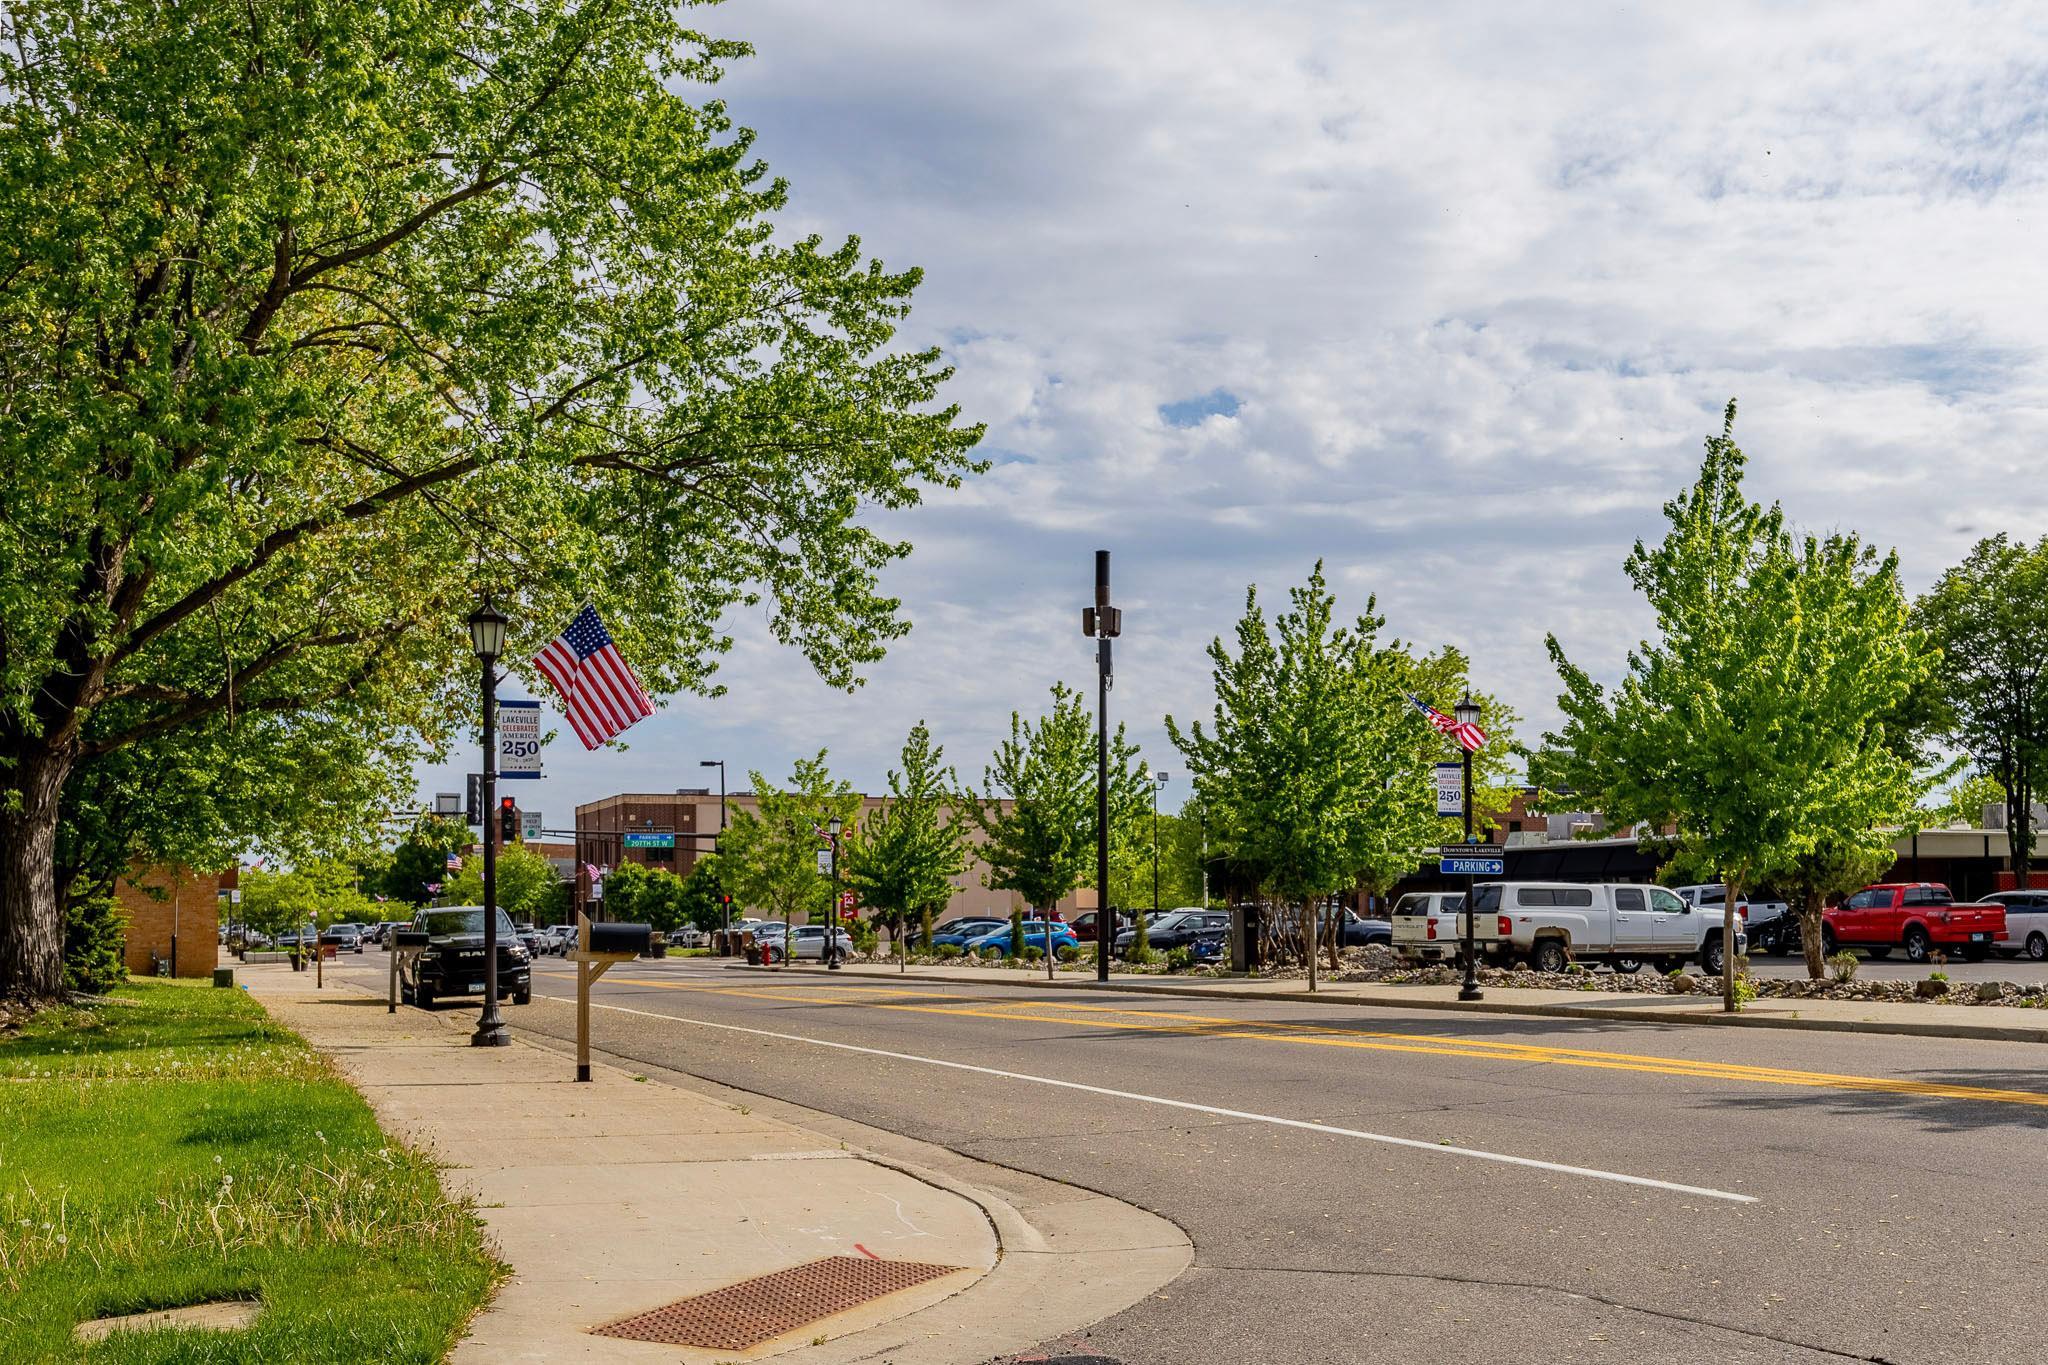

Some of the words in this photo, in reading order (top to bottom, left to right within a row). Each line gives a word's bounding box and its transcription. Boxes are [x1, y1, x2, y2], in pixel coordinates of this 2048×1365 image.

[502, 716, 538, 724] LAKEVILLE
[502, 740, 538, 757] 250
[1439, 790, 1461, 802] 250
[1453, 861, 1490, 872] PARKING
